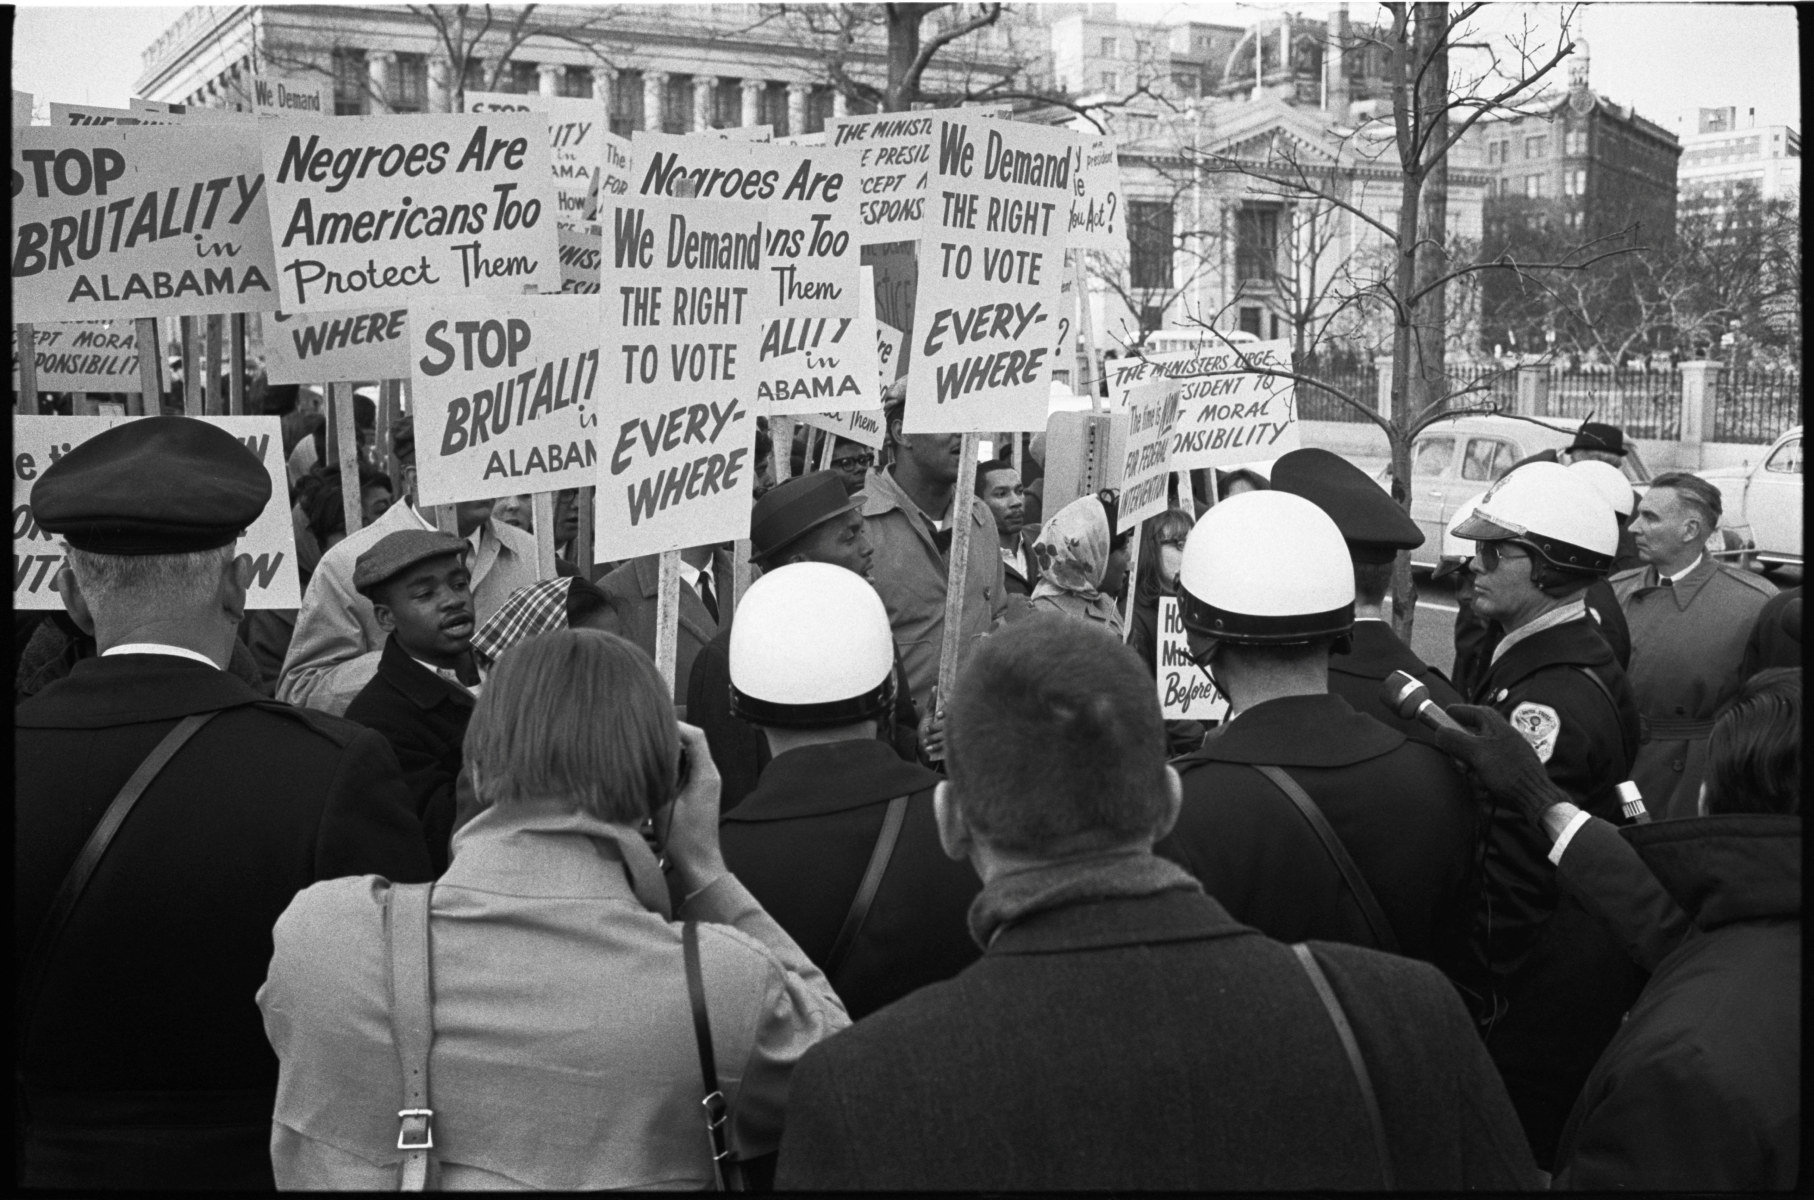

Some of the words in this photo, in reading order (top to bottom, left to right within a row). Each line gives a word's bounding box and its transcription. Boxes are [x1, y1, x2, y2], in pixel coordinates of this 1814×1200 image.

[255, 80, 273, 107] We
[278, 83, 320, 111] Demand
[834, 122, 871, 147] THE
[939, 121, 974, 178] We
[984, 129, 1072, 189] Demand
[276, 134, 450, 193] Negroes
[455, 125, 528, 172] Are
[781, 159, 844, 203] Are
[12, 173, 265, 278] BRUTALITY
[281, 196, 487, 247] Americans
[493, 182, 541, 232] Too
[807, 213, 850, 258] Too
[942, 191, 979, 229] THE
[986, 196, 1056, 236] RIGHT
[194, 233, 242, 258] in
[614, 207, 655, 270] We
[666, 213, 763, 271] Demand
[67, 265, 272, 303] ALABAMA
[284, 255, 440, 304] Protect
[450, 240, 538, 287] Them
[770, 263, 842, 307] Them
[941, 242, 972, 280] TO
[984, 247, 1043, 286] VOTE
[620, 286, 662, 327] THE
[673, 286, 748, 326] RIGHT
[72, 330, 138, 350] MORA
[292, 309, 408, 360] WHERE
[419, 318, 532, 377] STOP
[923, 301, 1048, 357] EVERY-
[622, 344, 658, 384] TO
[671, 343, 738, 382] VOTE
[805, 350, 840, 370] in
[936, 347, 1048, 405] WHERE
[1115, 364, 1149, 387] THE
[1149, 354, 1230, 377] MINISTERS
[440, 348, 599, 457] BRUTALIT
[757, 374, 861, 401] ABAMA
[1254, 374, 1276, 392] TO
[1196, 401, 1270, 424] MORAL
[610, 397, 747, 476] EVERY-
[482, 439, 597, 481] ALABA
[627, 447, 749, 527] WHERE
[1164, 671, 1212, 714] Before
